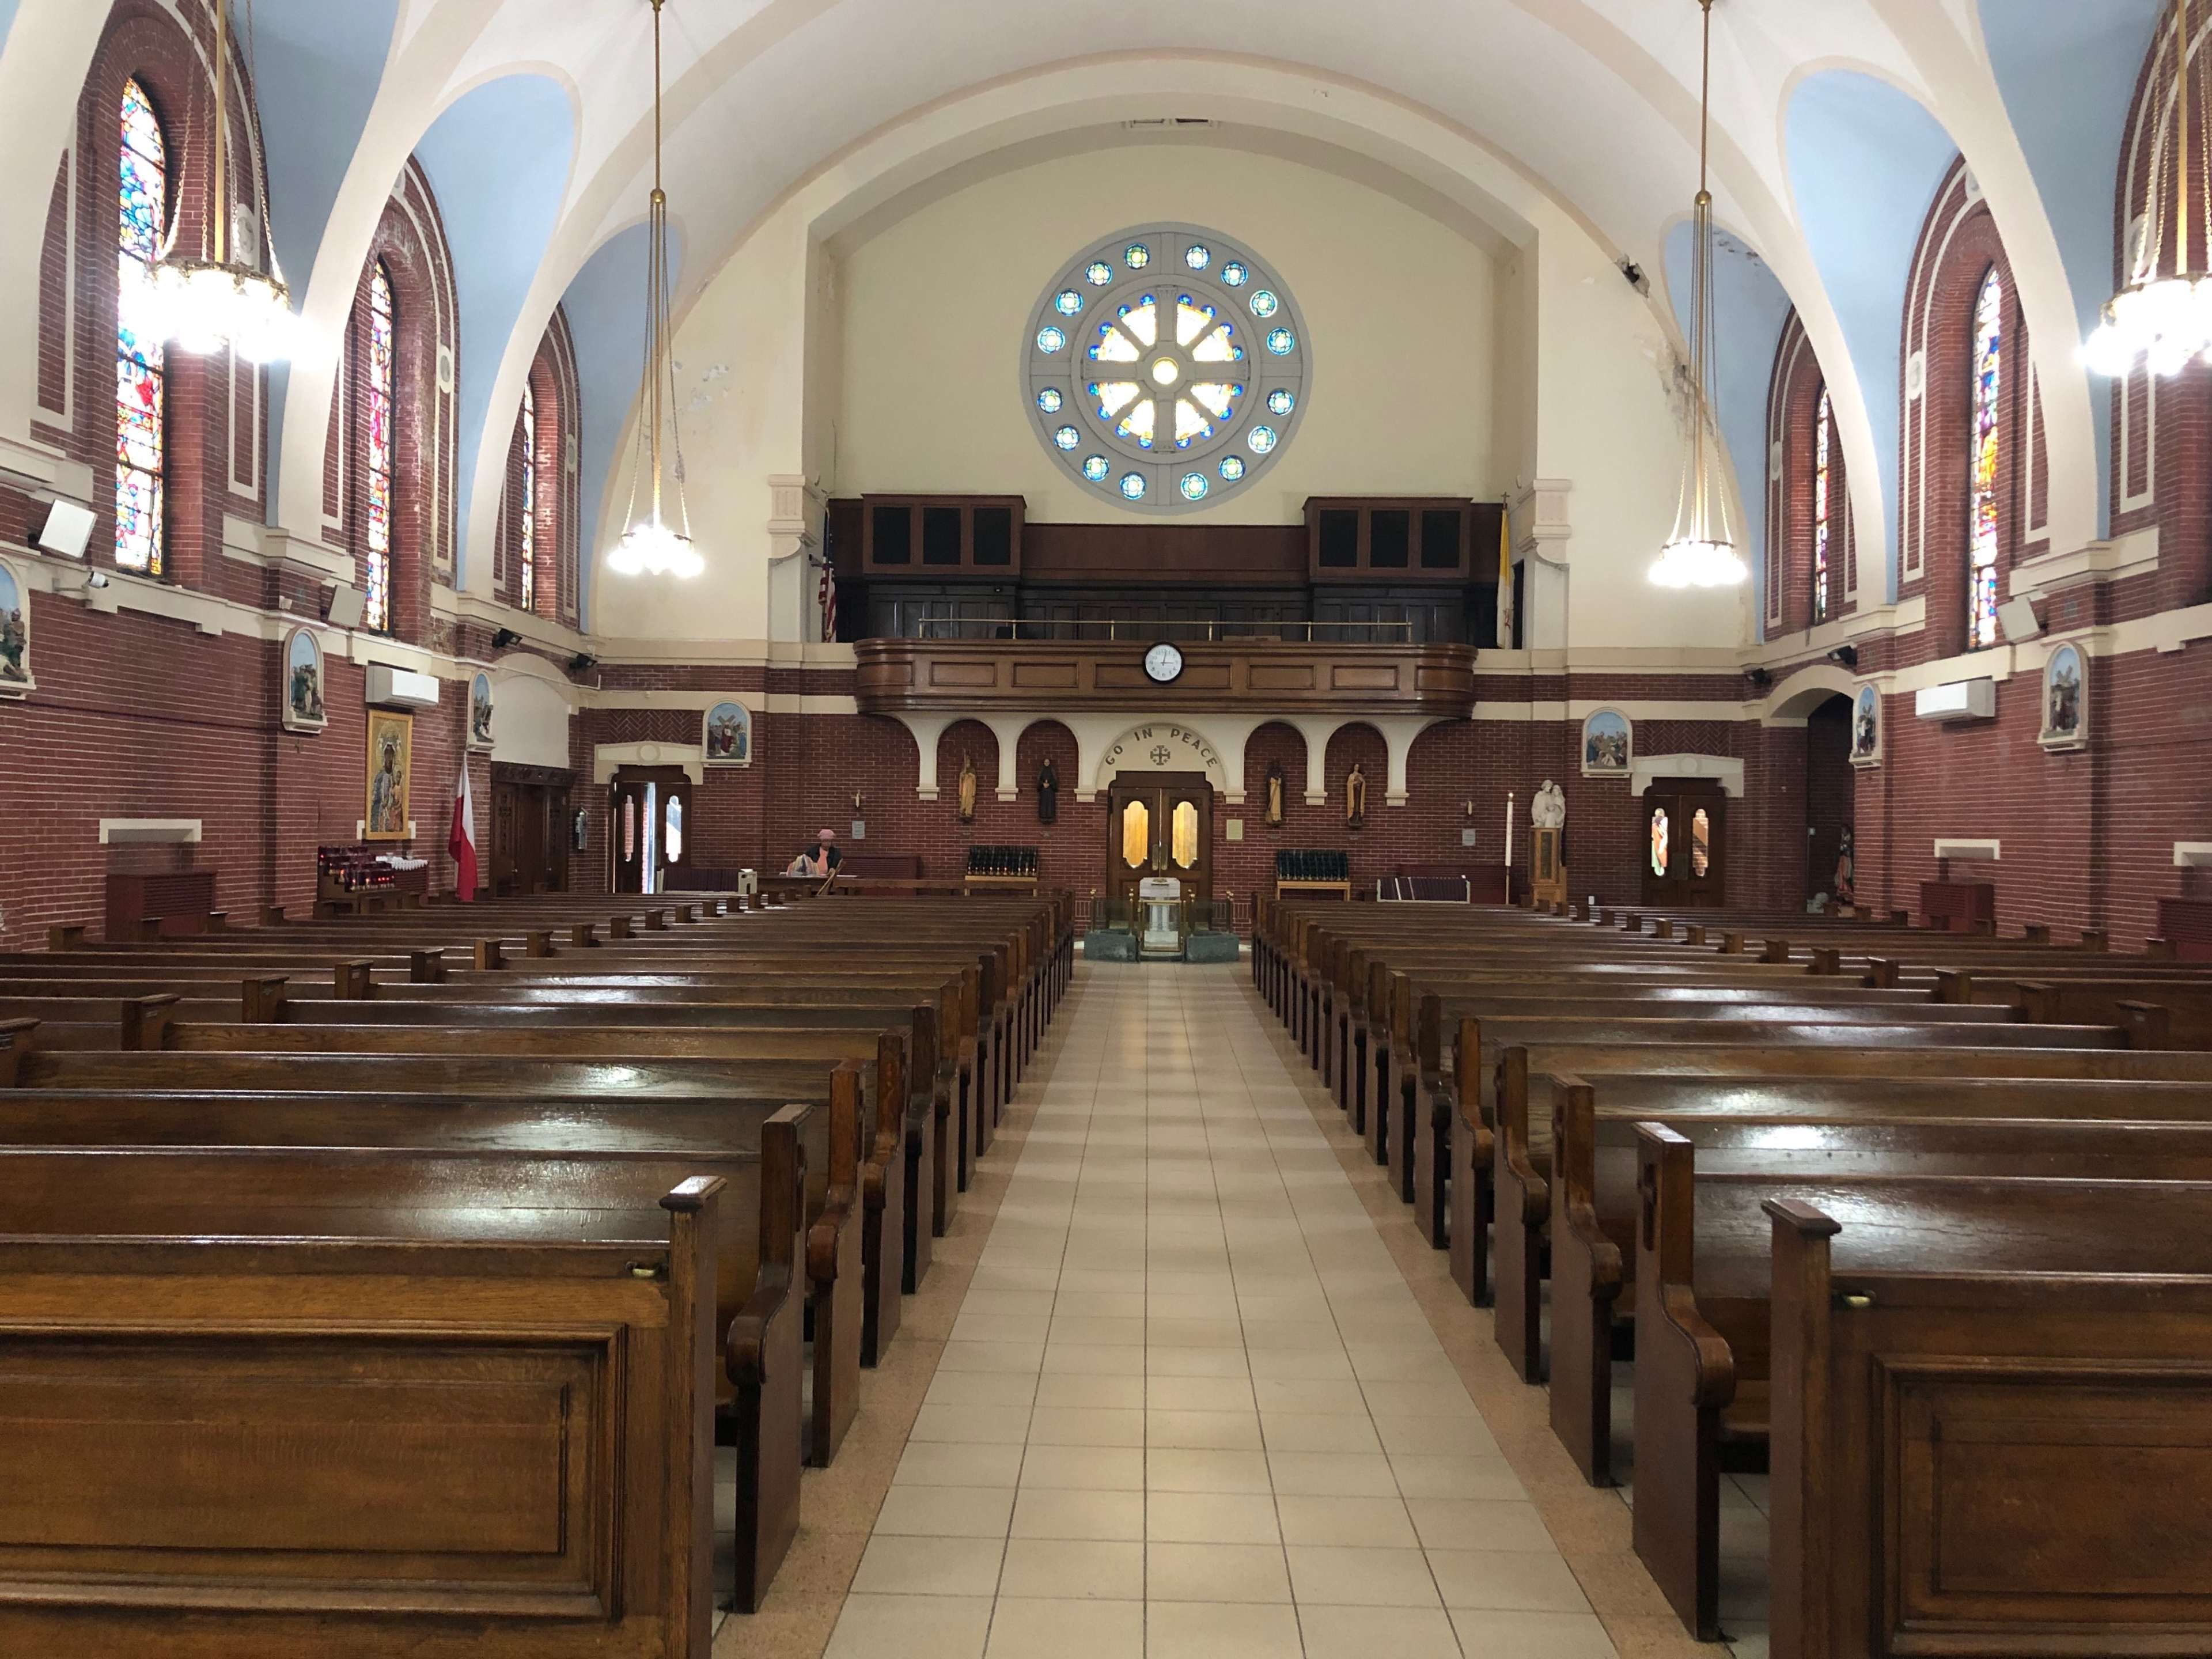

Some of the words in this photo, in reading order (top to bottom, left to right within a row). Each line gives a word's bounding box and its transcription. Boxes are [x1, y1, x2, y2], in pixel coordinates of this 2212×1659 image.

[1105, 745, 1123, 765] GO
[1134, 728, 1153, 741] IN
[1171, 728, 1217, 767] PEACE
